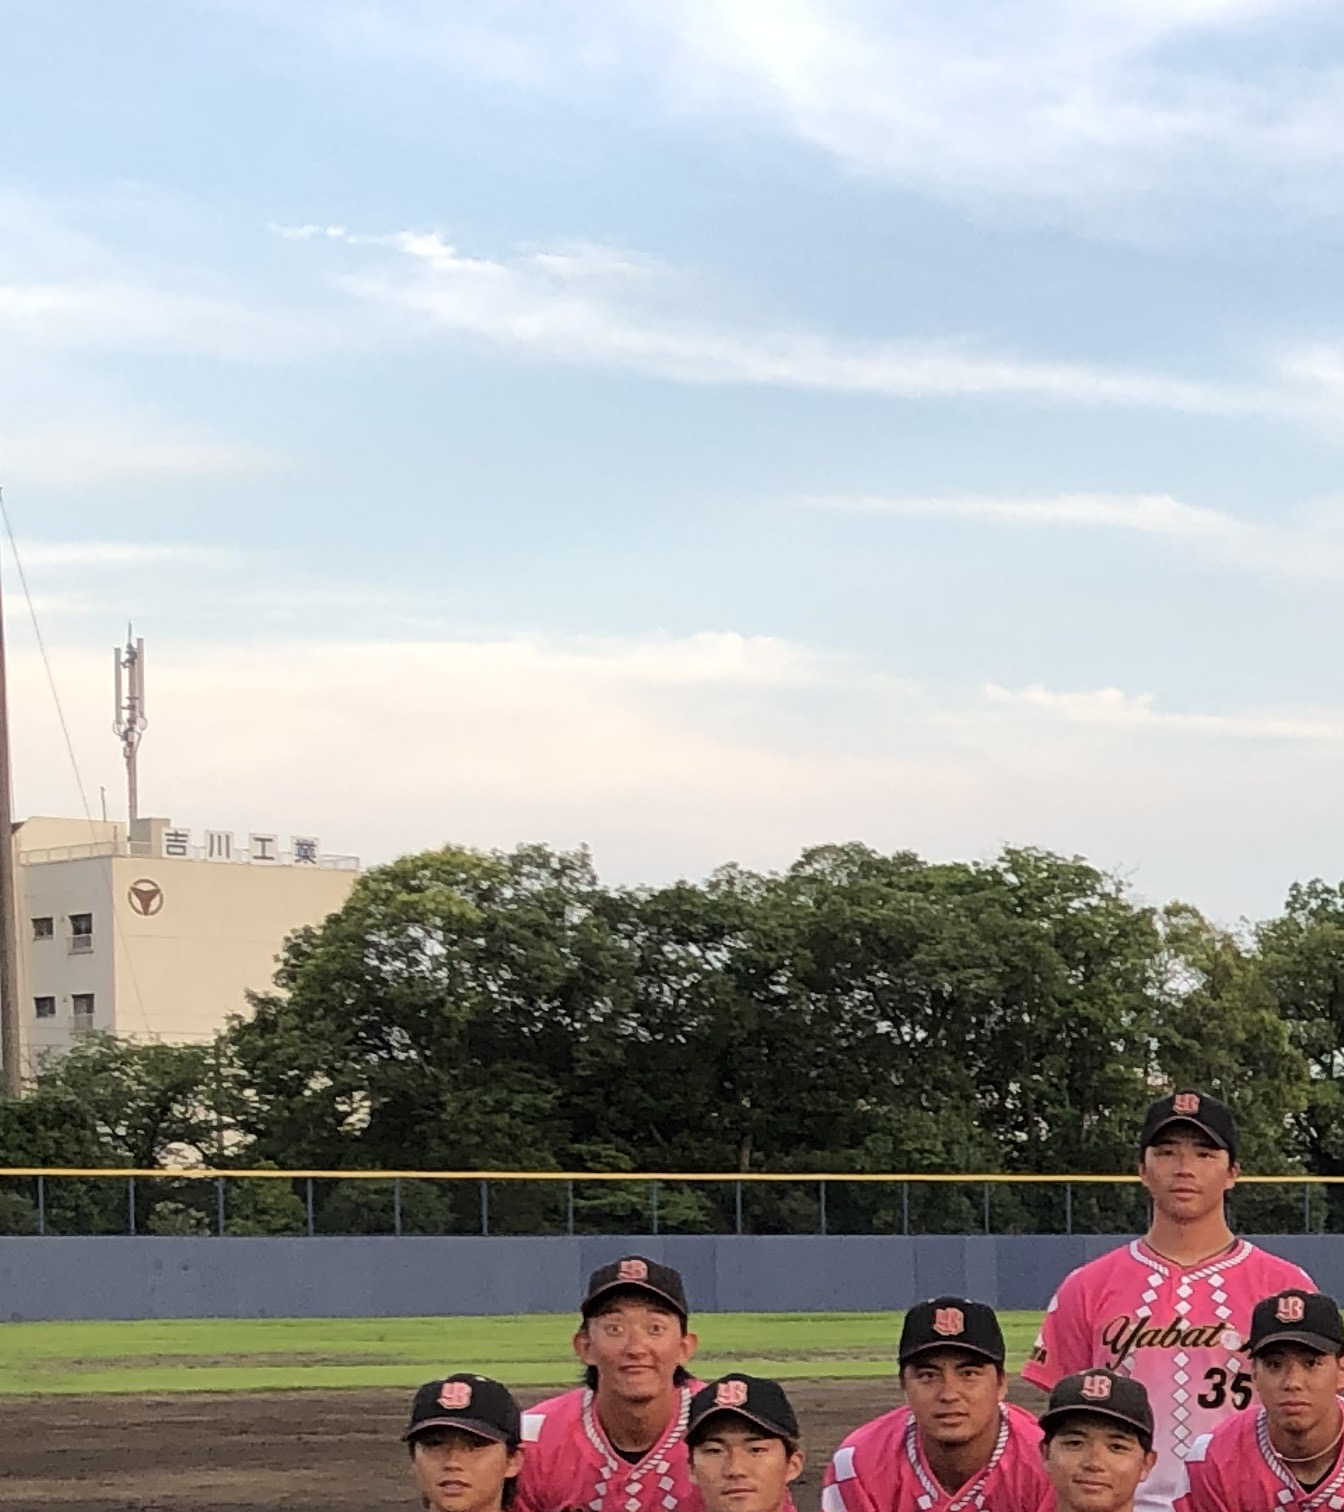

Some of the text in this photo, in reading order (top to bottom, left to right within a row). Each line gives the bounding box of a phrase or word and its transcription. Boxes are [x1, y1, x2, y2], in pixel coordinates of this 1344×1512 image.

[165, 830, 318, 864] 吉川工業
[1197, 1367, 1253, 1410] 35
